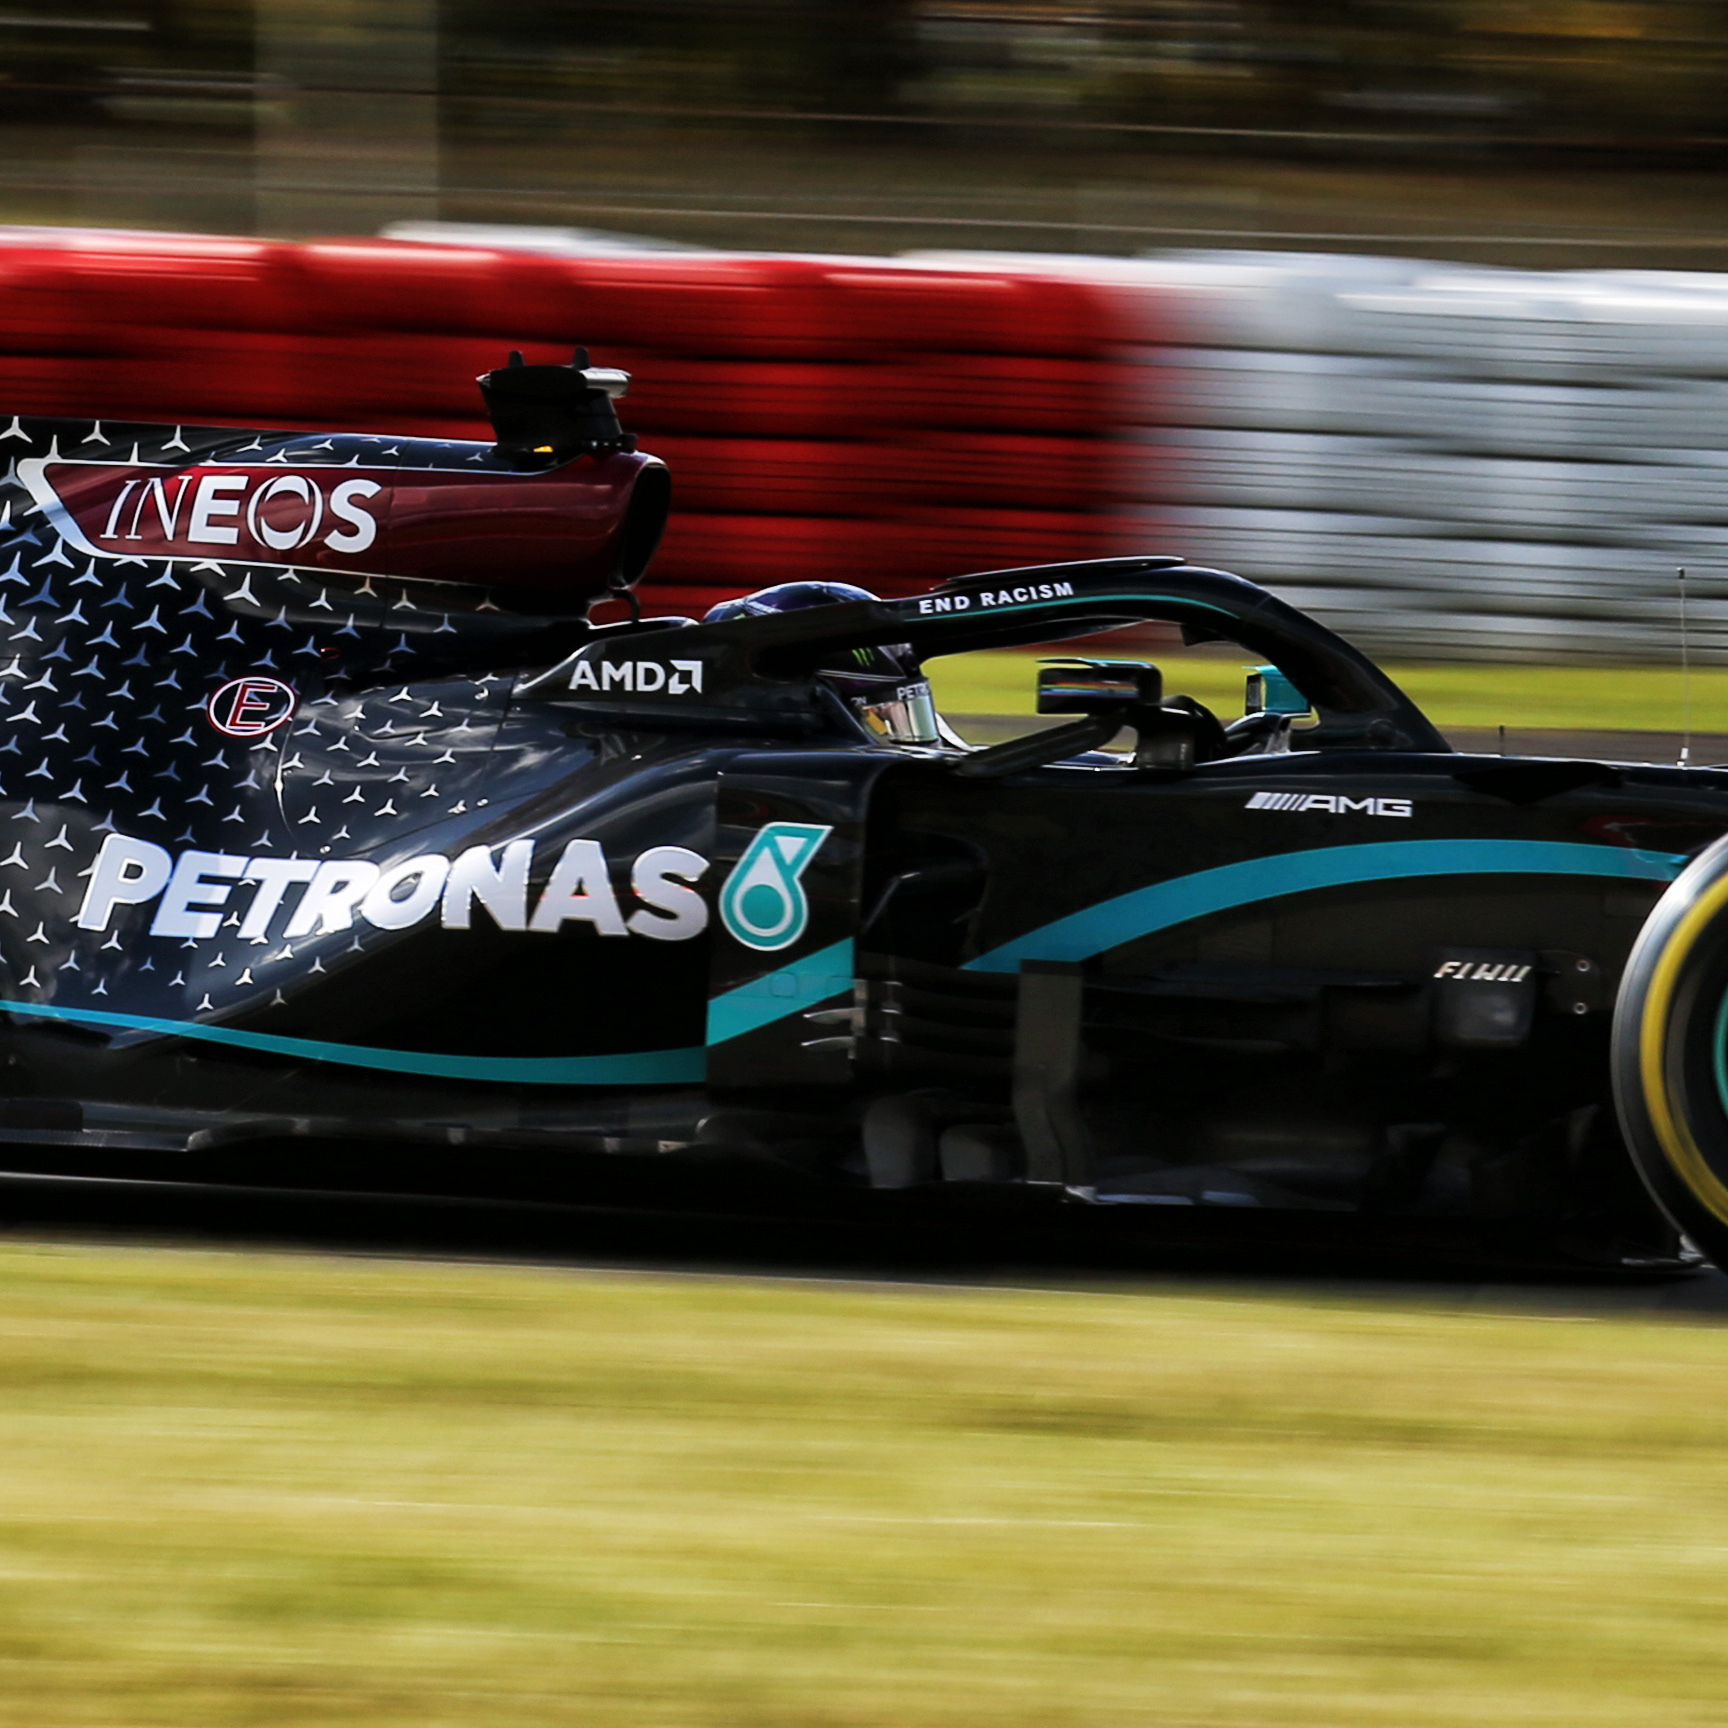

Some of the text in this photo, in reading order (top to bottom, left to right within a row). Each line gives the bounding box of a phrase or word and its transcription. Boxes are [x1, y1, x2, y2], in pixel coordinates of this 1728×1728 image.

[100, 474, 381, 553] INEOS
[919, 582, 1074, 615] END RACISM
[569, 660, 666, 692] AMD
[78, 834, 709, 941] PETRONAS
